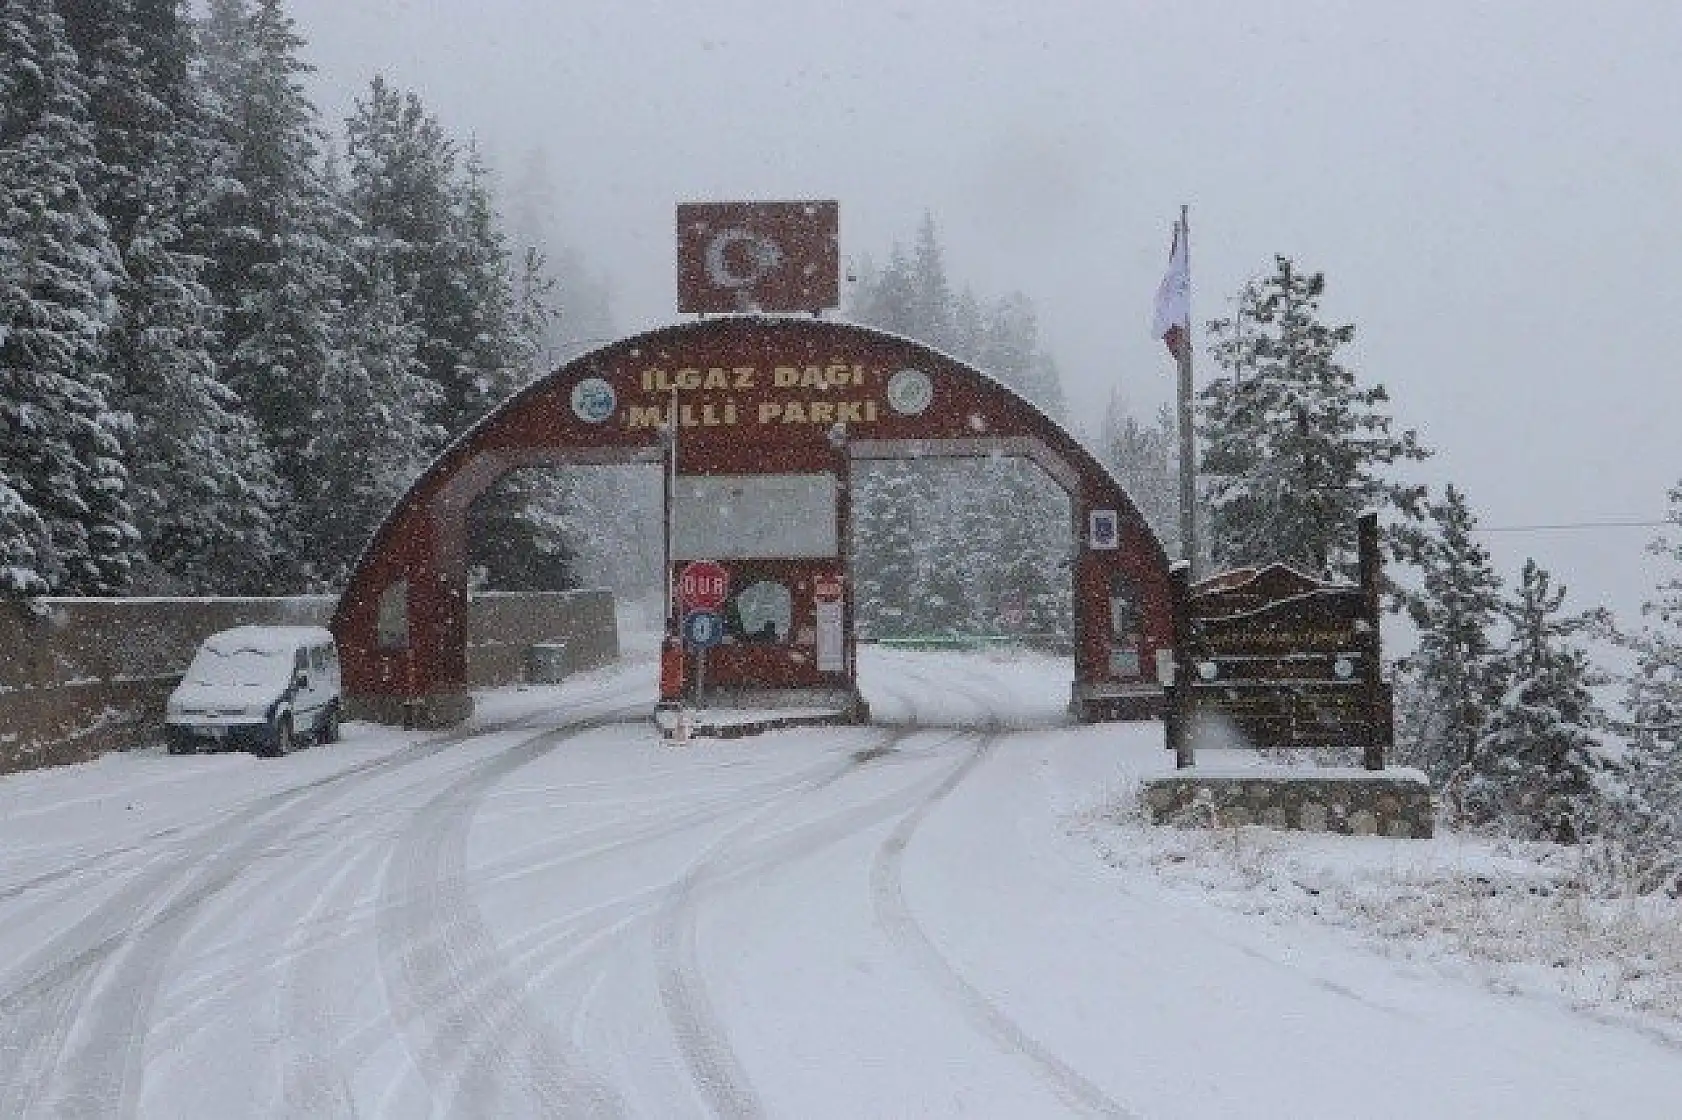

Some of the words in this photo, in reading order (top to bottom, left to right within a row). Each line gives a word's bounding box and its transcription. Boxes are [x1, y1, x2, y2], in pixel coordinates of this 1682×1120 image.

[774, 355, 864, 388] DAĞI
[628, 399, 737, 427] MLLİ
[684, 576, 723, 595] DUR
